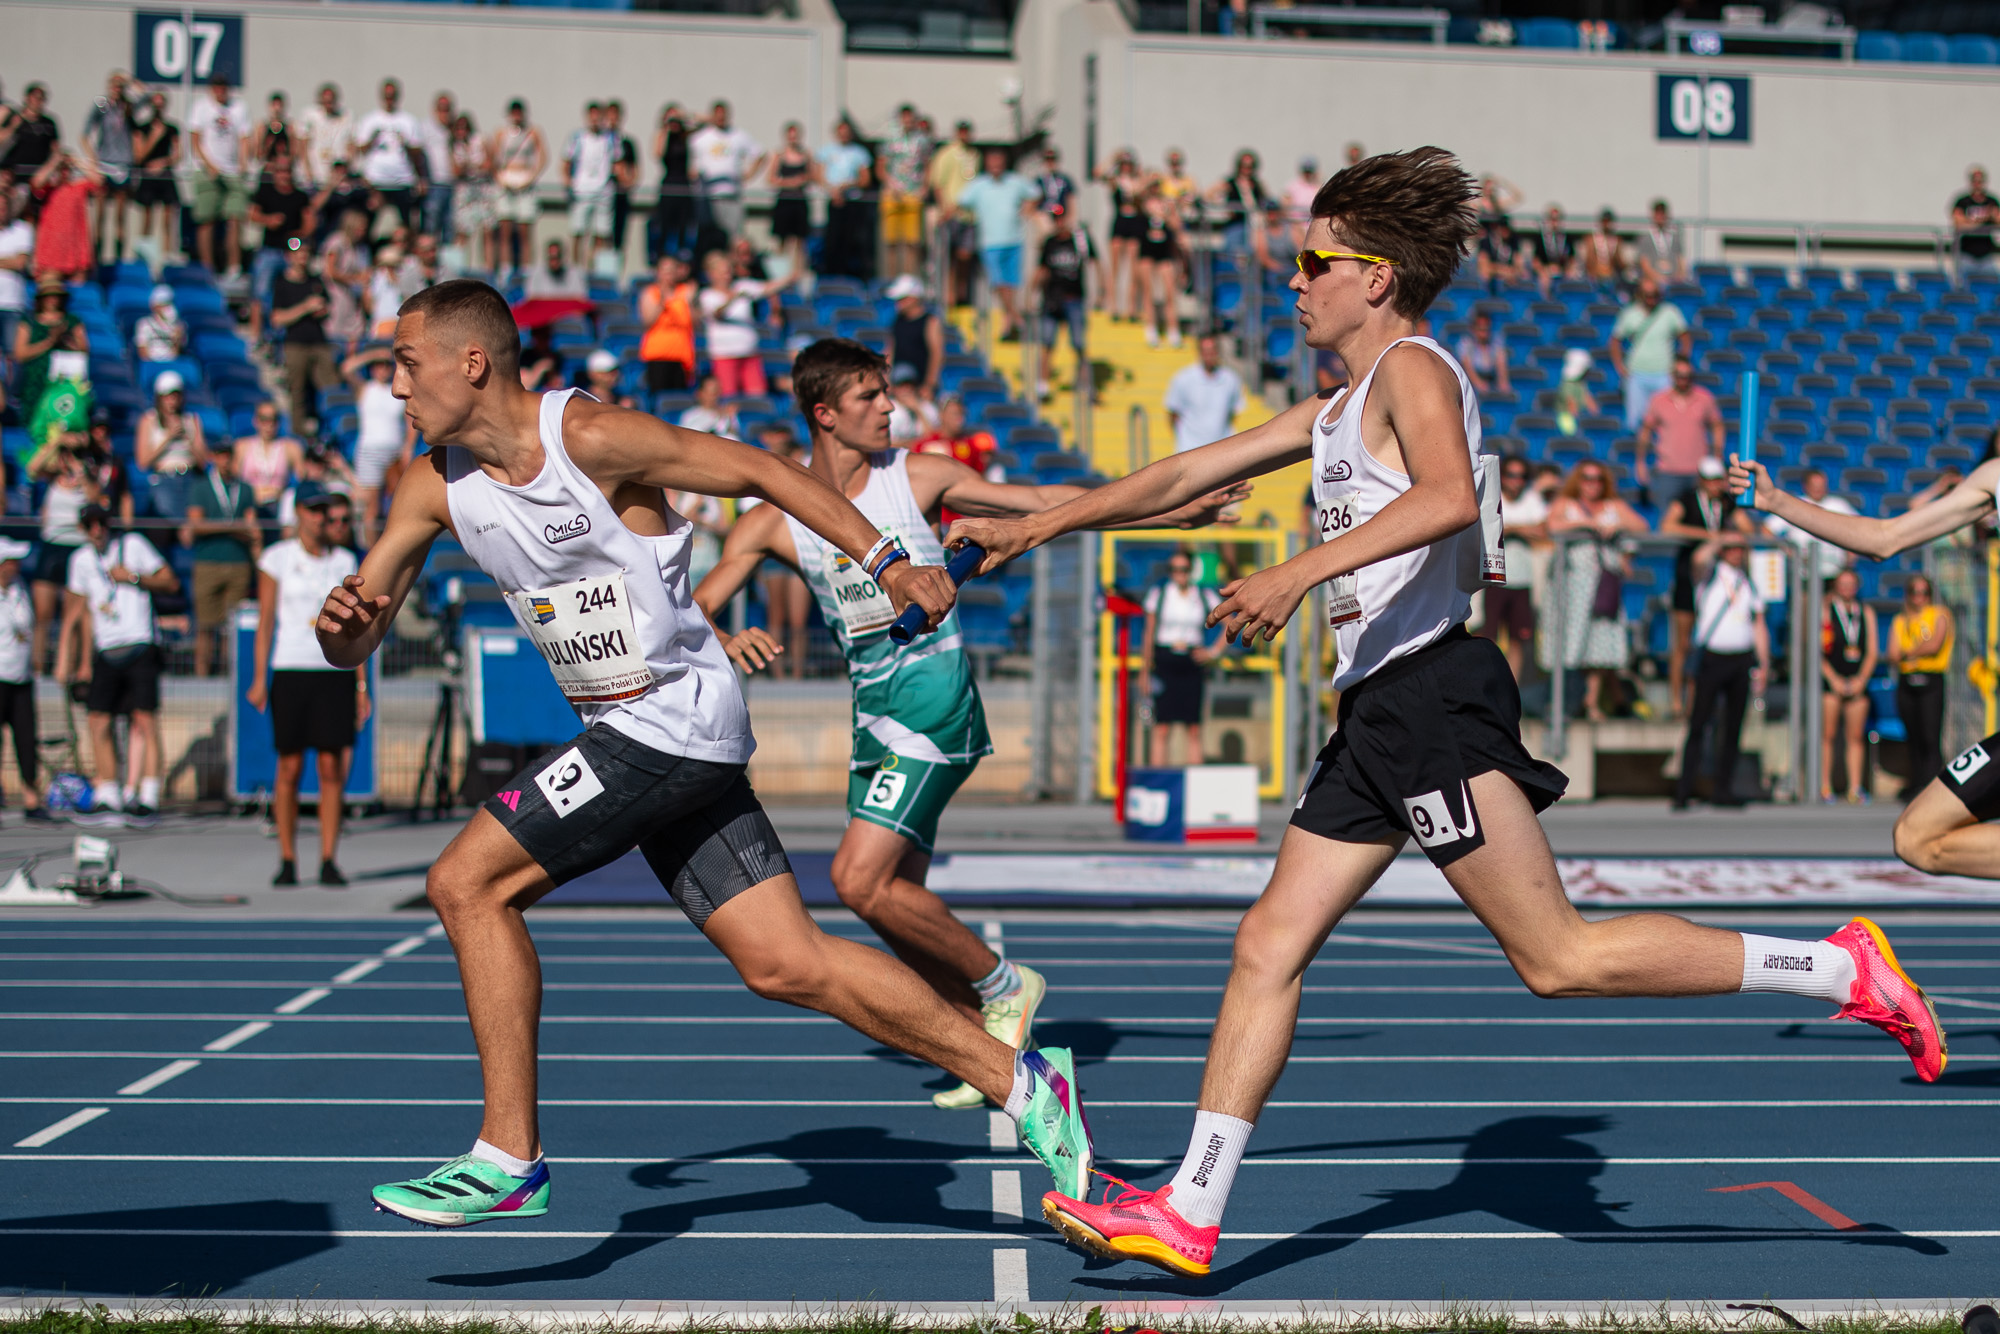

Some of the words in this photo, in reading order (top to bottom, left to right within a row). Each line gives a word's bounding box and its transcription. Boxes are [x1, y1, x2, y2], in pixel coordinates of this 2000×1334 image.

[152, 19, 225, 78] 07
[1670, 80, 1735, 135] 08
[1320, 505, 1352, 533] 236
[575, 584, 617, 614] 244
[611, 679, 633, 690] Polski
[634, 673, 652, 685] U18
[1953, 747, 1982, 771] 5
[873, 774, 896, 803] 5
[1412, 805, 1449, 838] 9.
